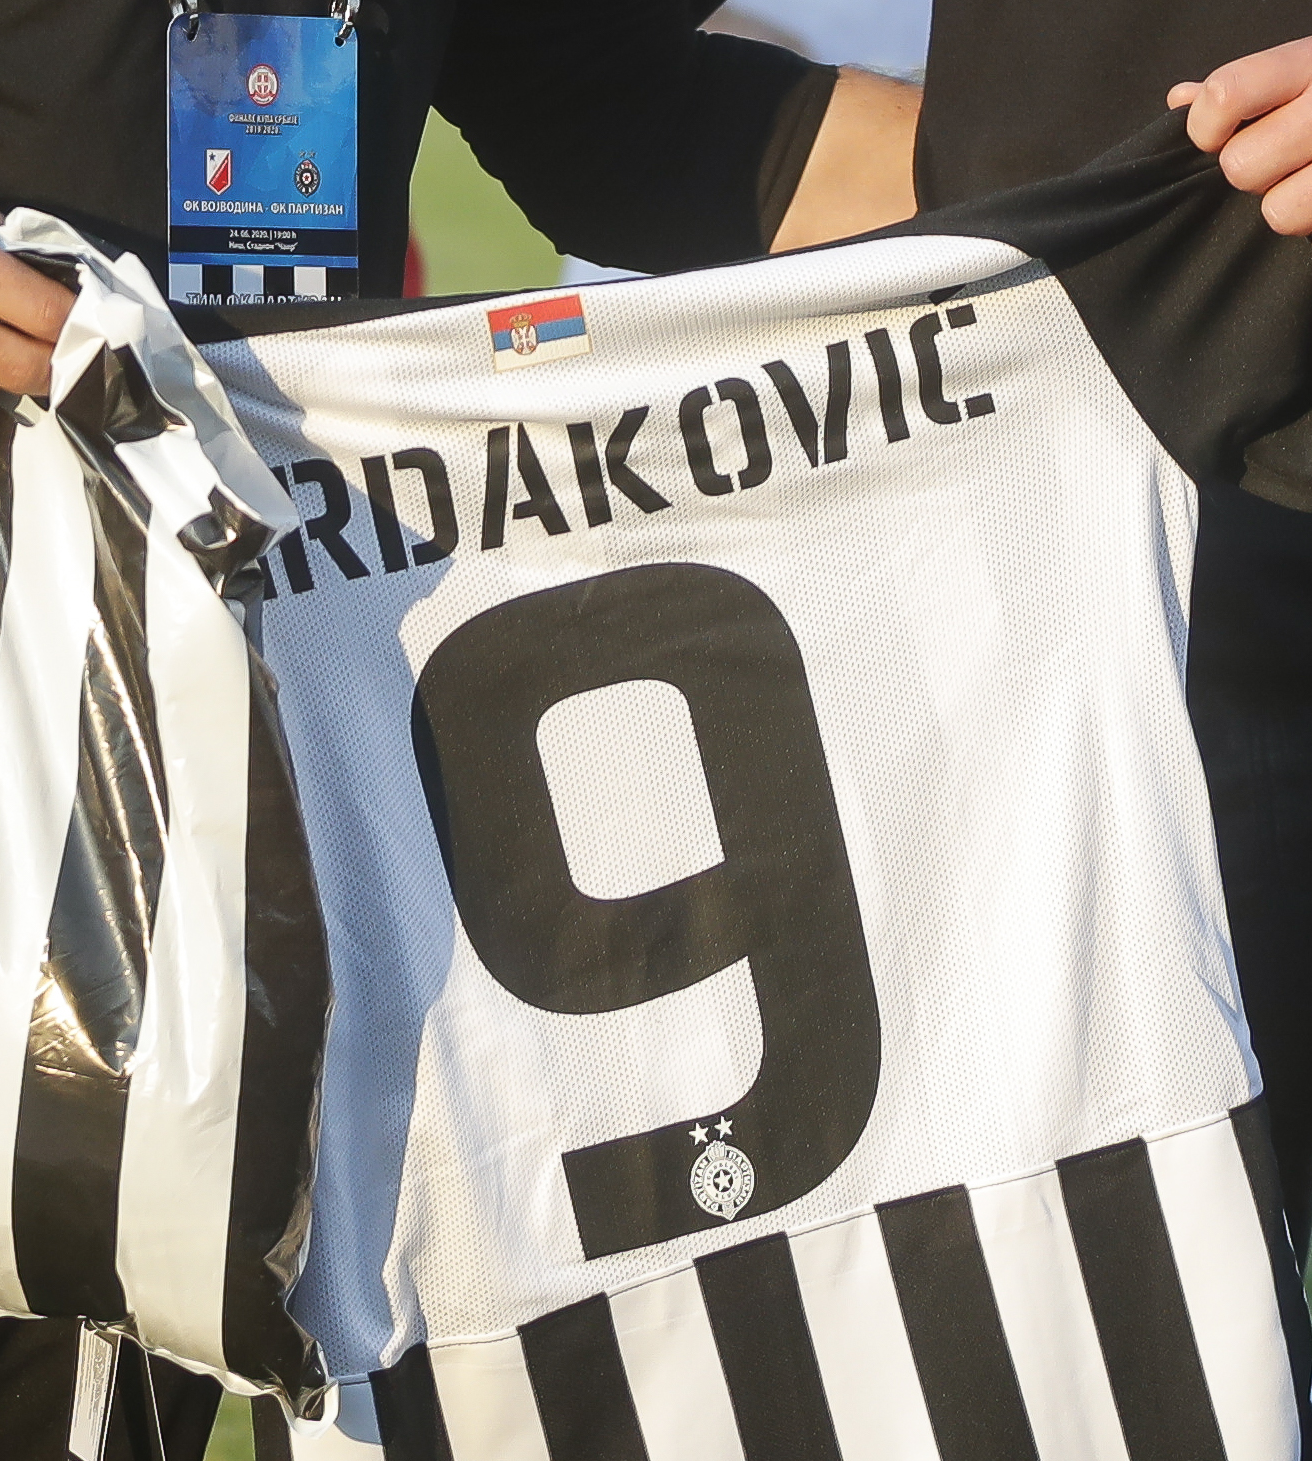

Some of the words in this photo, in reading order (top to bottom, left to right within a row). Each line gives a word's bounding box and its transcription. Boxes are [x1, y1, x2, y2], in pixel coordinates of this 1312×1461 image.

[183, 200, 200, 212] ФК
[201, 201, 263, 214] ВОЈВОДИНА
[270, 202, 287, 214] ФК
[289, 203, 344, 215] ПАРТИЗАН
[256, 283, 996, 600] RDAKOVIĆ
[411, 562, 881, 1261] 9
